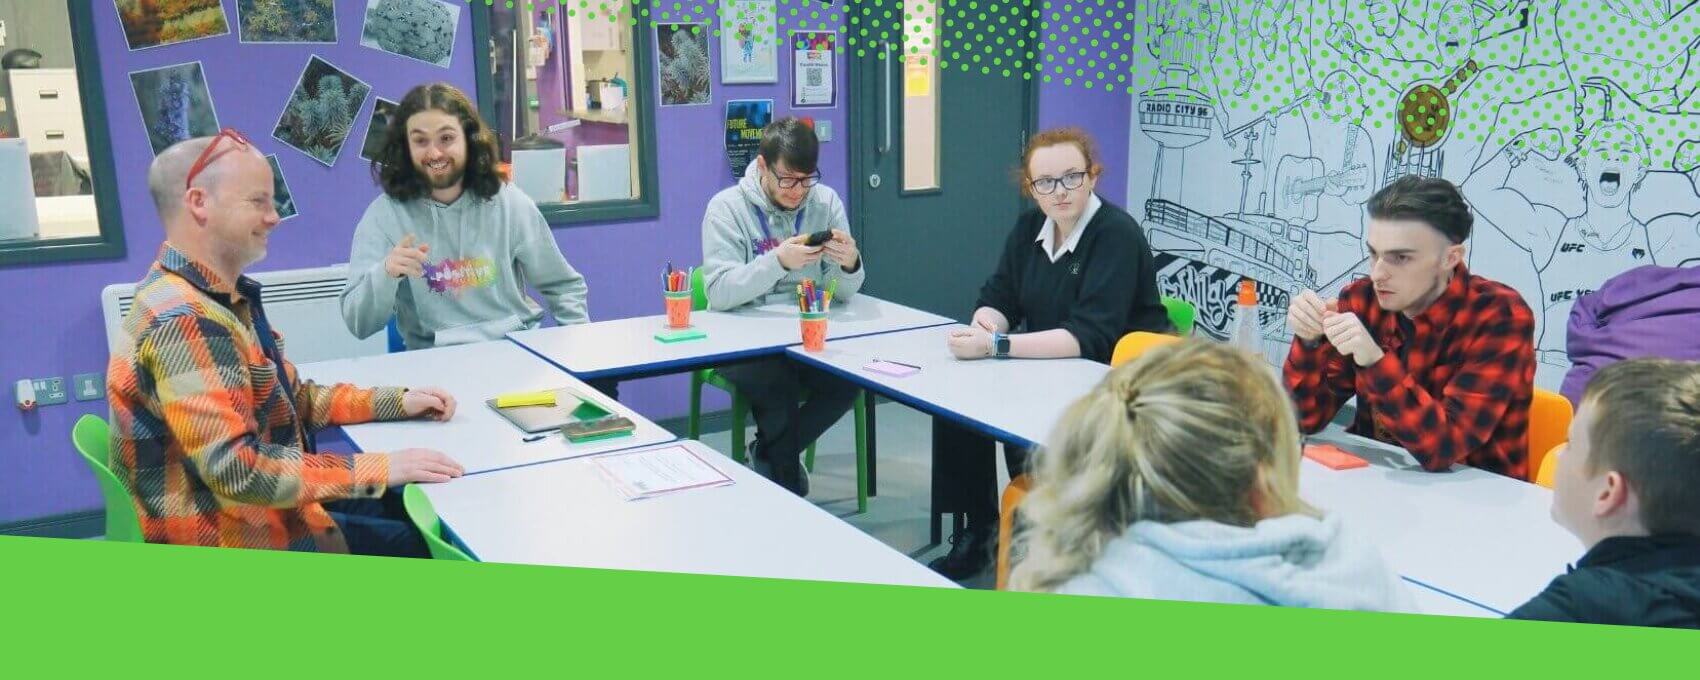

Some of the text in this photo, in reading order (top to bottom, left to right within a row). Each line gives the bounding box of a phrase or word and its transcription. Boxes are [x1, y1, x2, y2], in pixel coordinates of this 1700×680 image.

[1146, 103, 1171, 113] RADIO
[1175, 104, 1195, 115] CITY
[1560, 243, 1585, 253] UFC
[1550, 290, 1573, 302] UFC
